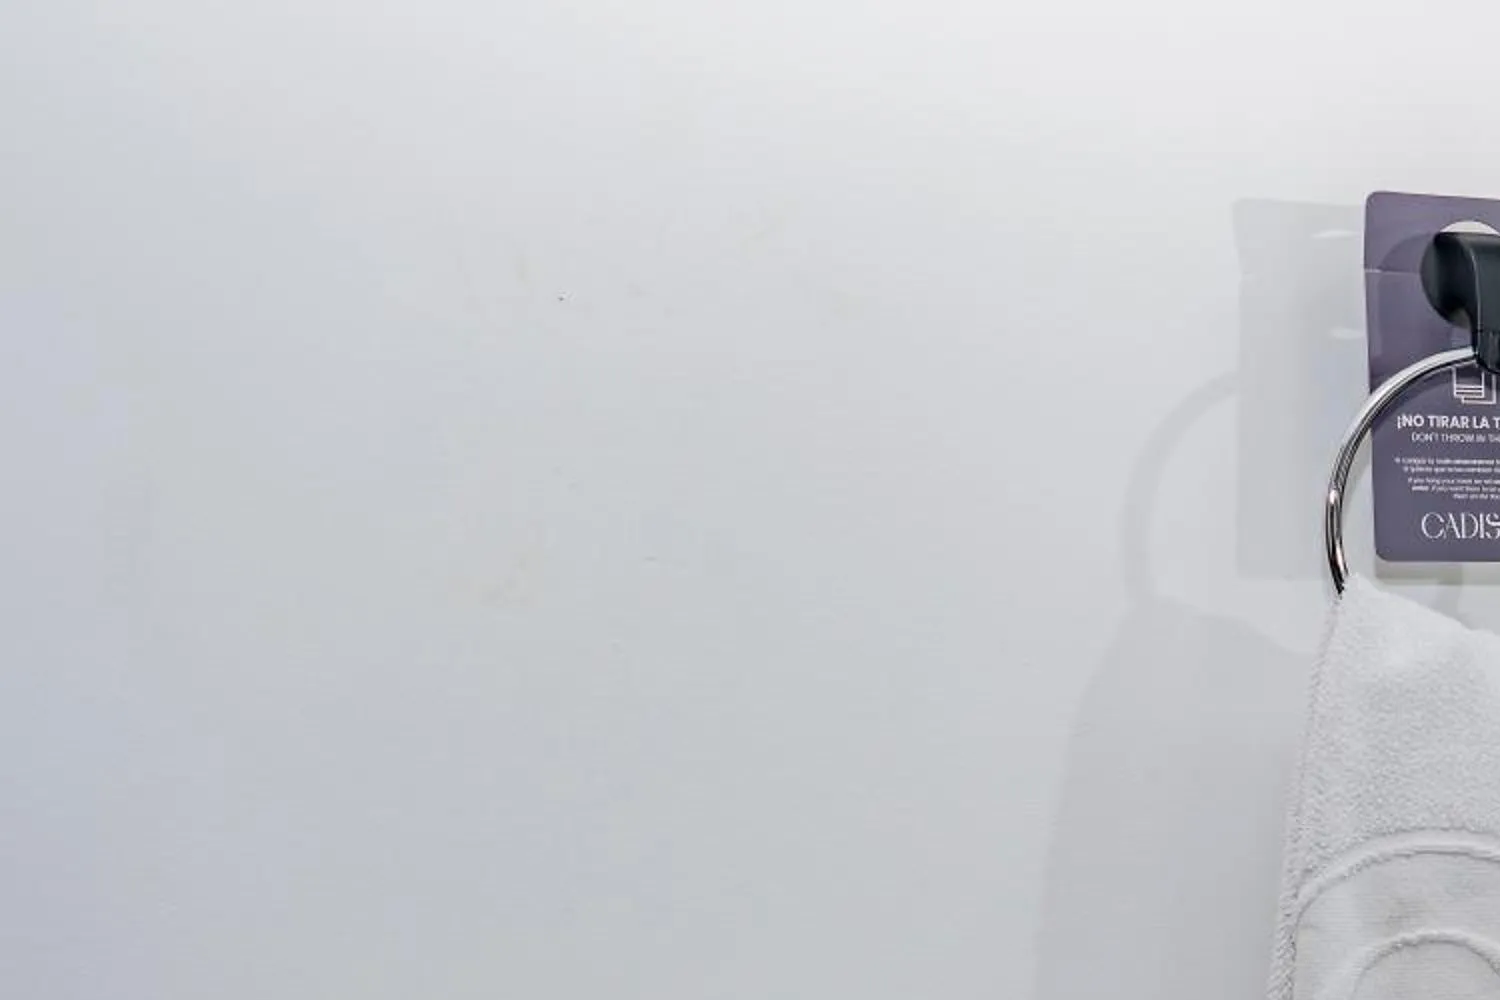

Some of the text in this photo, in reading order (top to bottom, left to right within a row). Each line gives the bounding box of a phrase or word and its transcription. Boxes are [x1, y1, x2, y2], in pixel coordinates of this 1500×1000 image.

[1397, 414, 1424, 429] ¡NO
[1427, 415, 1469, 429] TIRAR
[1472, 416, 1490, 430] LA
